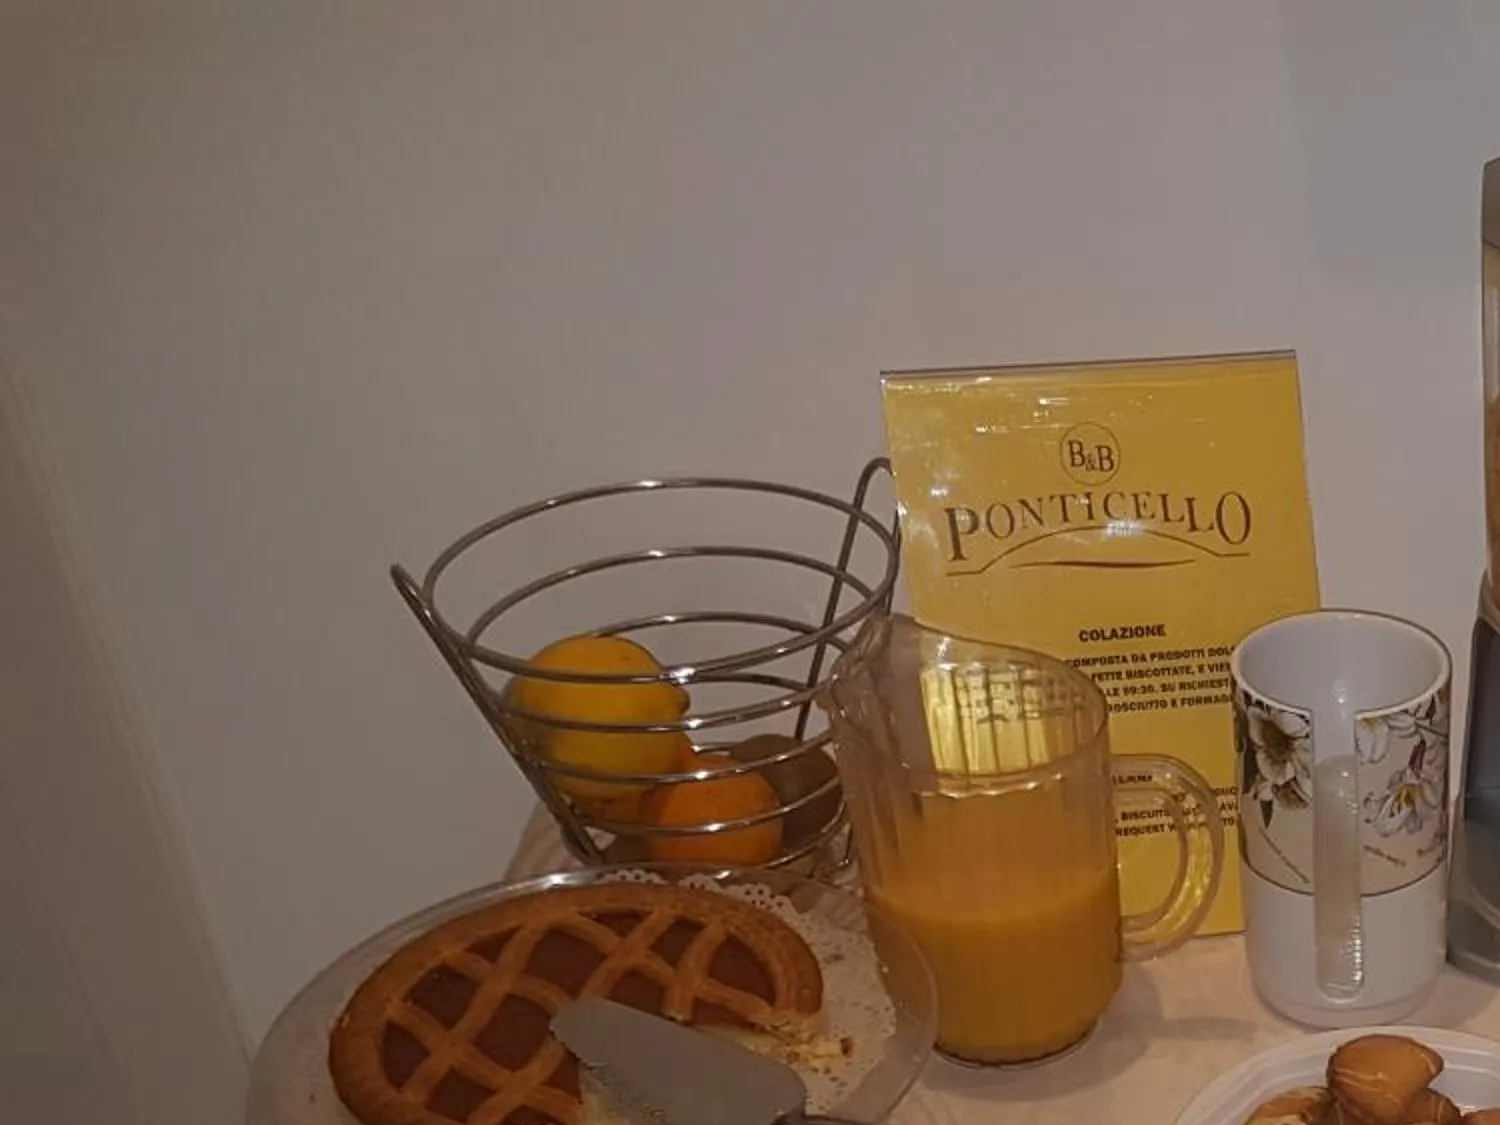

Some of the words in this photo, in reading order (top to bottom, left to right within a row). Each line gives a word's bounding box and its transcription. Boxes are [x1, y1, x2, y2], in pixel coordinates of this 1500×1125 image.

[1067, 439, 1115, 474] B&B
[944, 489, 1252, 562] PONTICELLO
[1078, 624, 1167, 643] COLAZIONE
[1131, 653, 1147, 664] DA
[1178, 678, 1230, 693] RICHIEST
